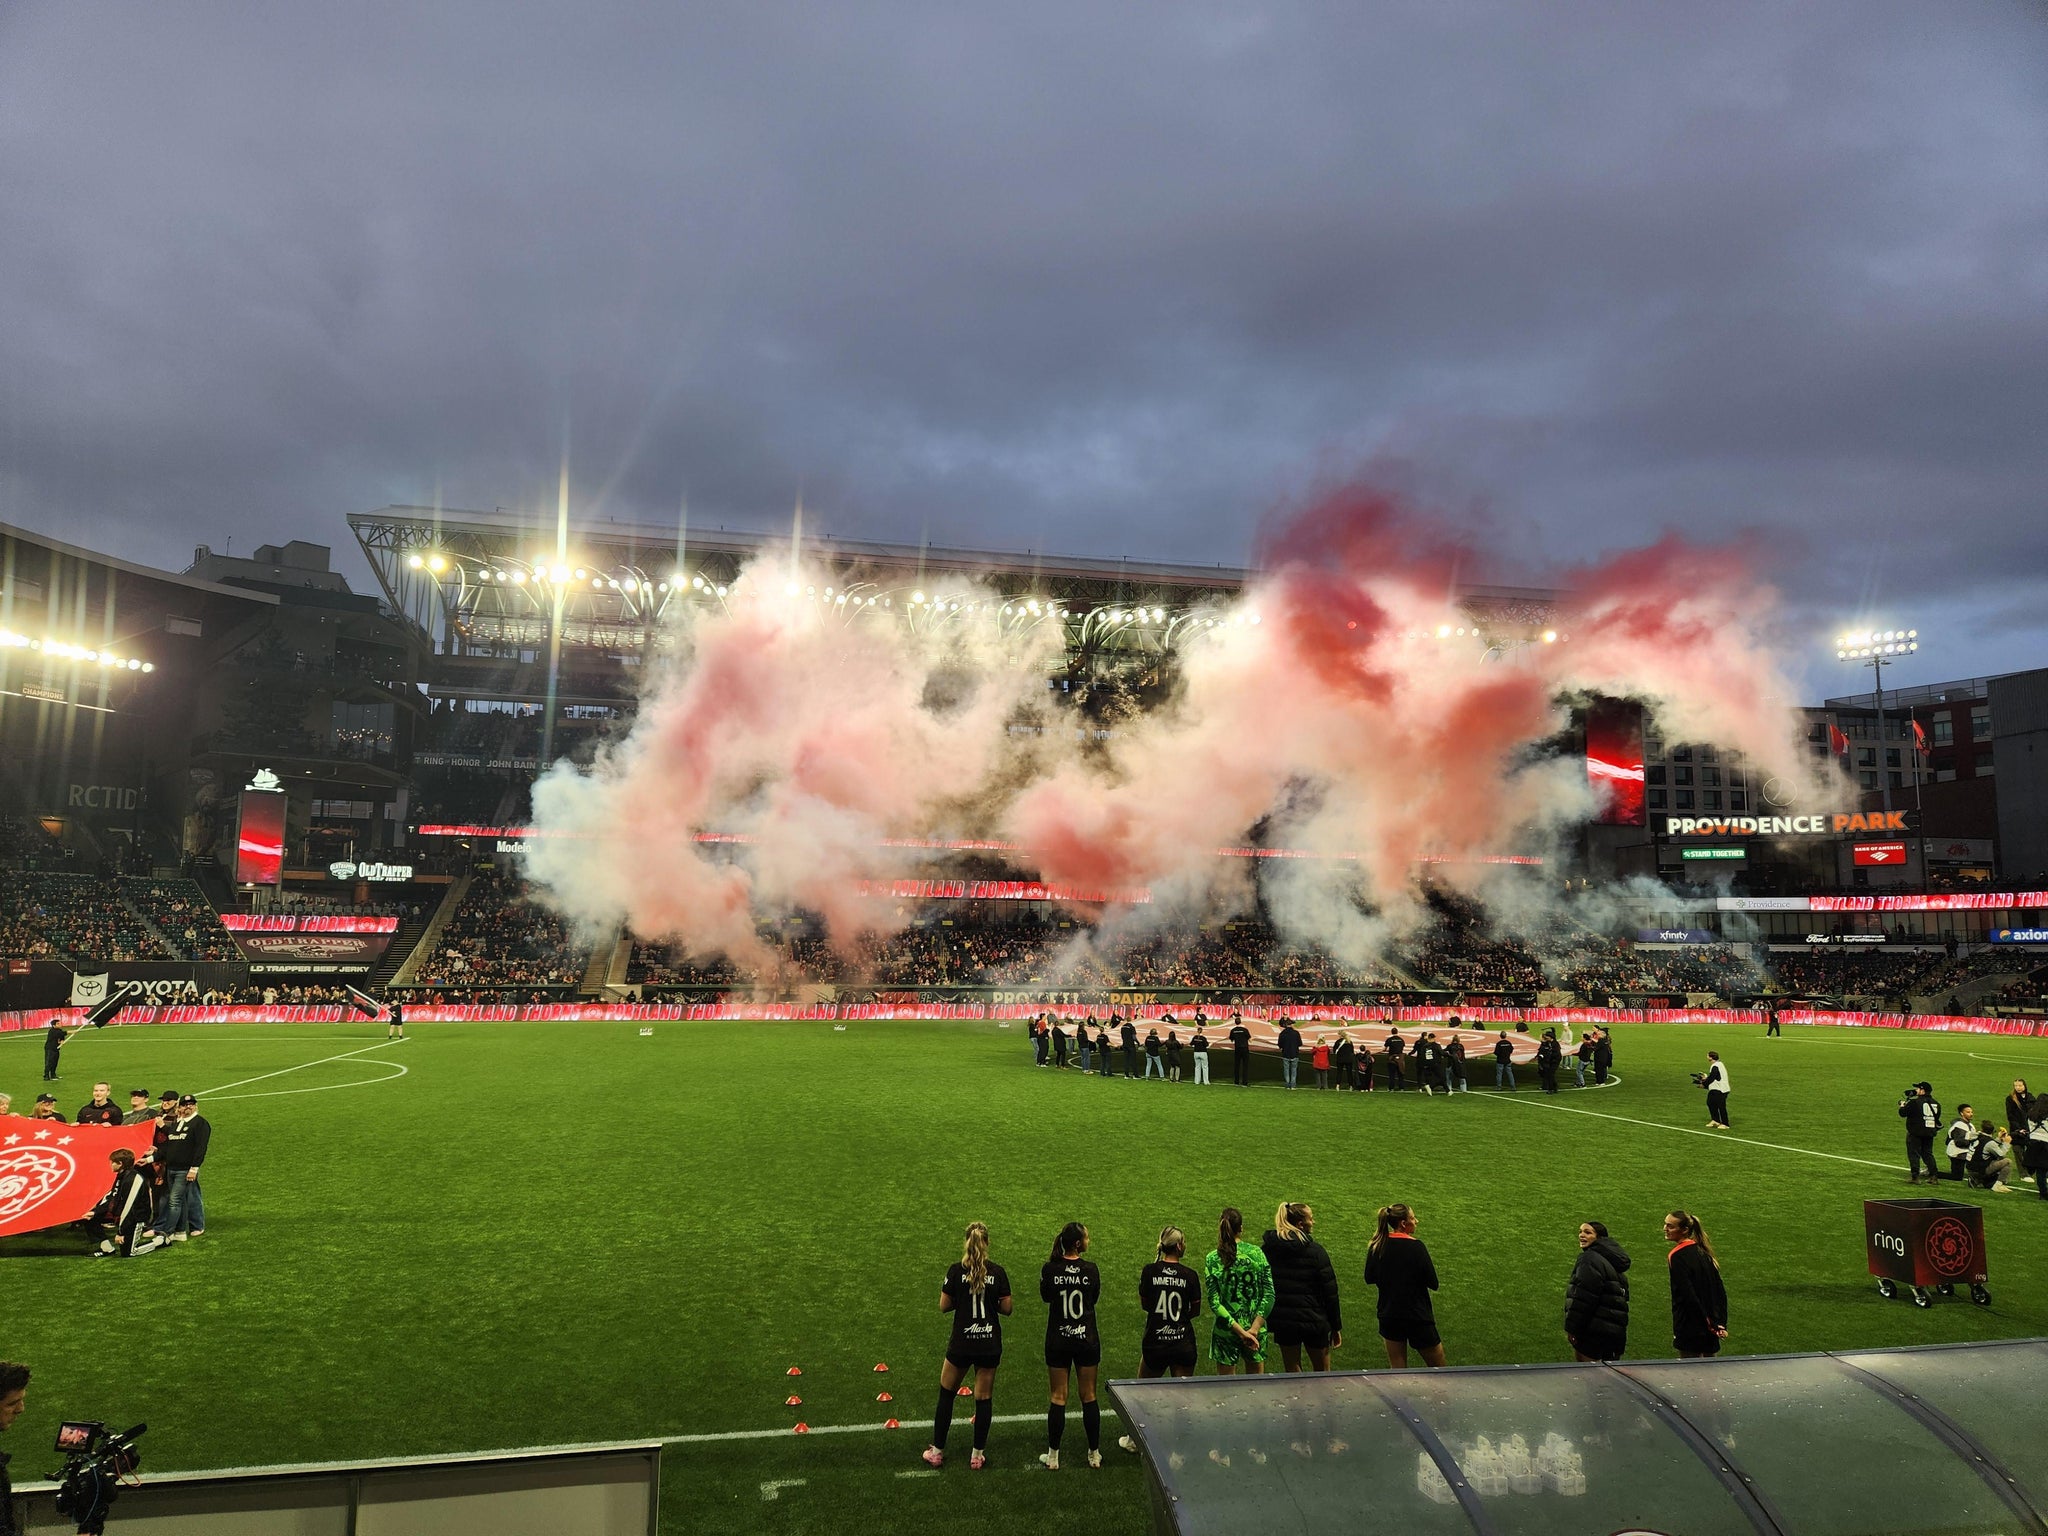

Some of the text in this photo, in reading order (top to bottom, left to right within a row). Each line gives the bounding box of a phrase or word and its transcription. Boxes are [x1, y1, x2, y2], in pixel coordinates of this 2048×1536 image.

[424, 757, 444, 765] RING
[451, 758, 480, 767] HONOR
[486, 760, 512, 769] JOHN
[513, 761, 536, 769] BAIN
[69, 784, 138, 811] RCTID
[1668, 811, 1906, 835] PROVIDENCE PARK
[496, 841, 532, 853] Modelo
[892, 880, 965, 898] PORTLAND
[970, 881, 1024, 900] THORNS
[1748, 900, 1790, 909] Providence
[1811, 896, 1874, 911] PORTLAND
[1876, 896, 1928, 911] THORNS
[1948, 893, 2014, 910] PORTLAND
[221, 914, 295, 931] PORTLAND
[300, 915, 355, 932] THORNS
[1660, 931, 1688, 940] xfinity
[1806, 934, 1830, 943] Ford
[115, 980, 198, 997] TOYOTA
[161, 1005, 230, 1024] THORNS
[260, 1005, 342, 1023] PORTLAND
[436, 1005, 518, 1022] PORTLAND
[522, 1005, 581, 1022] THORNS
[607, 1004, 682, 1021] PORTLAND
[686, 1004, 741, 1021] THORNS
[765, 1004, 839, 1020] PORTLAND
[842, 1004, 896, 1020] THORNS
[916, 1004, 985, 1020] PORTLAND
[1398, 1006, 1443, 1021] THORNS
[1587, 1008, 1644, 1023] PORTLAND
[1647, 1009, 1689, 1023] THORNS
[1706, 1009, 1763, 1024] PORTLAND
[1838, 1011, 1905, 1029] PORTLAND
[1908, 1014, 1954, 1031] THORNS
[1968, 1016, 2035, 1035] PORTLAND
[1874, 1230, 1905, 1257] ring
[1054, 1275, 1090, 1286] DEYNA C.
[1152, 1276, 1187, 1288] IMMETHUN
[1975, 1273, 1987, 1282] ring
[972, 1292, 986, 1319] 11
[1060, 1289, 1084, 1320] 10
[1154, 1289, 1182, 1322] 40
